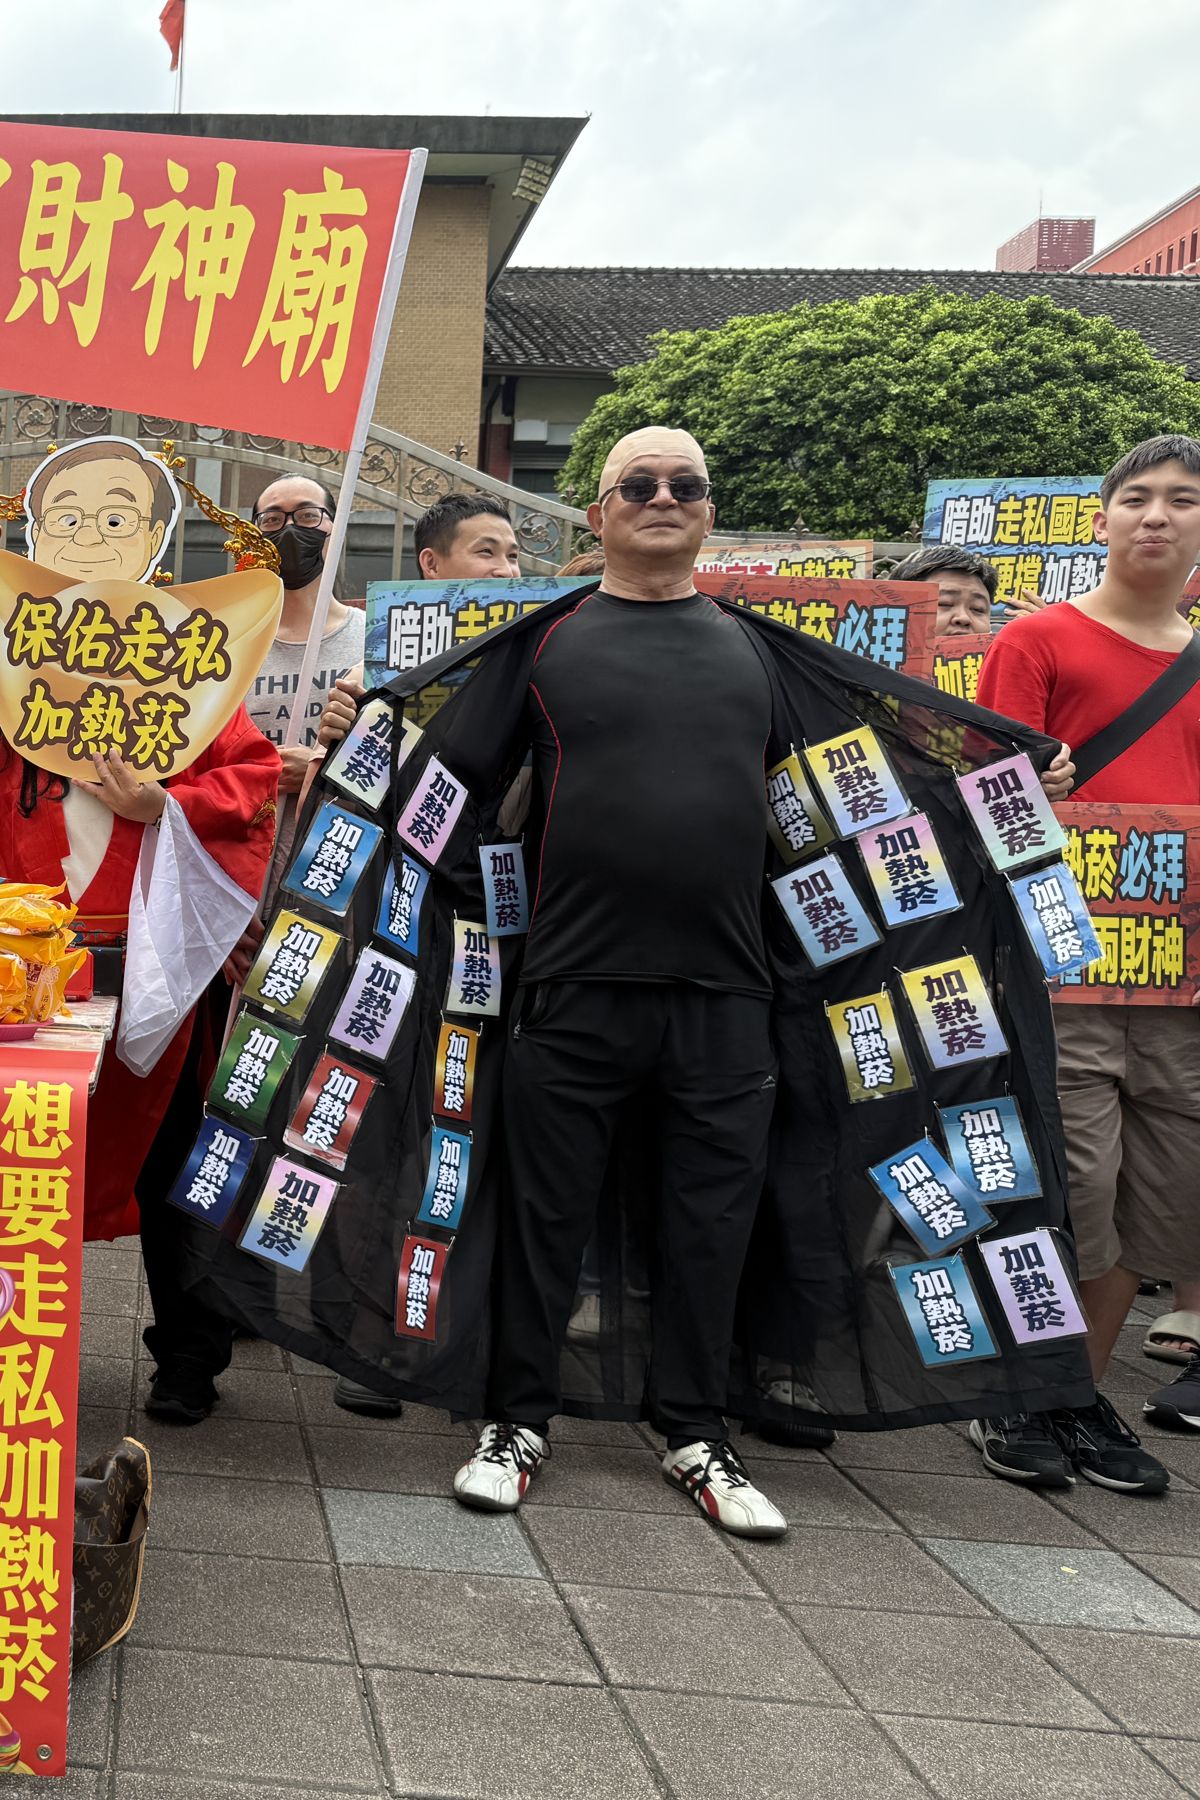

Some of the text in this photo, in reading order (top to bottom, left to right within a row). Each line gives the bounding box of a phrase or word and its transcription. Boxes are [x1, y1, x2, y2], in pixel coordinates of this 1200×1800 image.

[7, 596, 229, 687] 保佑走私
[18, 683, 189, 769] 加熱菸
[276, 702, 323, 720] AD
[340, 711, 408, 792] 加熱菸
[407, 770, 457, 849] 加熱菸
[766, 769, 818, 853] 加熱菸
[822, 738, 889, 824] 加熱菸
[976, 767, 1047, 857] 加熱菸
[302, 815, 364, 898] 加熱菸
[489, 851, 521, 929] 加熱菸
[874, 826, 939, 913] 加熱菸
[387, 861, 421, 943] 加熱菸
[790, 869, 859, 955] 加熱菸
[1028, 877, 1084, 964] 加熱菸
[260, 921, 323, 1007] 加熱菸
[460, 928, 493, 1008] 加熱菸
[1059, 915, 1184, 987] 兩財神
[343, 960, 402, 1045] 加熱菸
[920, 969, 988, 1058] 加熱菸
[223, 1026, 280, 1110] 加熱菸
[442, 1032, 468, 1114] 加熱菸
[845, 1004, 895, 1091] 加熱菸
[302, 1068, 358, 1152] 加熱菸
[959, 1108, 1018, 1194] 加熱菸
[185, 1128, 240, 1211] 加熱菸
[431, 1136, 461, 1220] 加熱菸
[889, 1155, 969, 1240] 加熱菸
[260, 1170, 321, 1258] 加熱菸
[405, 1245, 434, 1331] 加熱菸
[912, 1269, 973, 1355] 加熱菸
[998, 1241, 1067, 1333] 加熱菸
